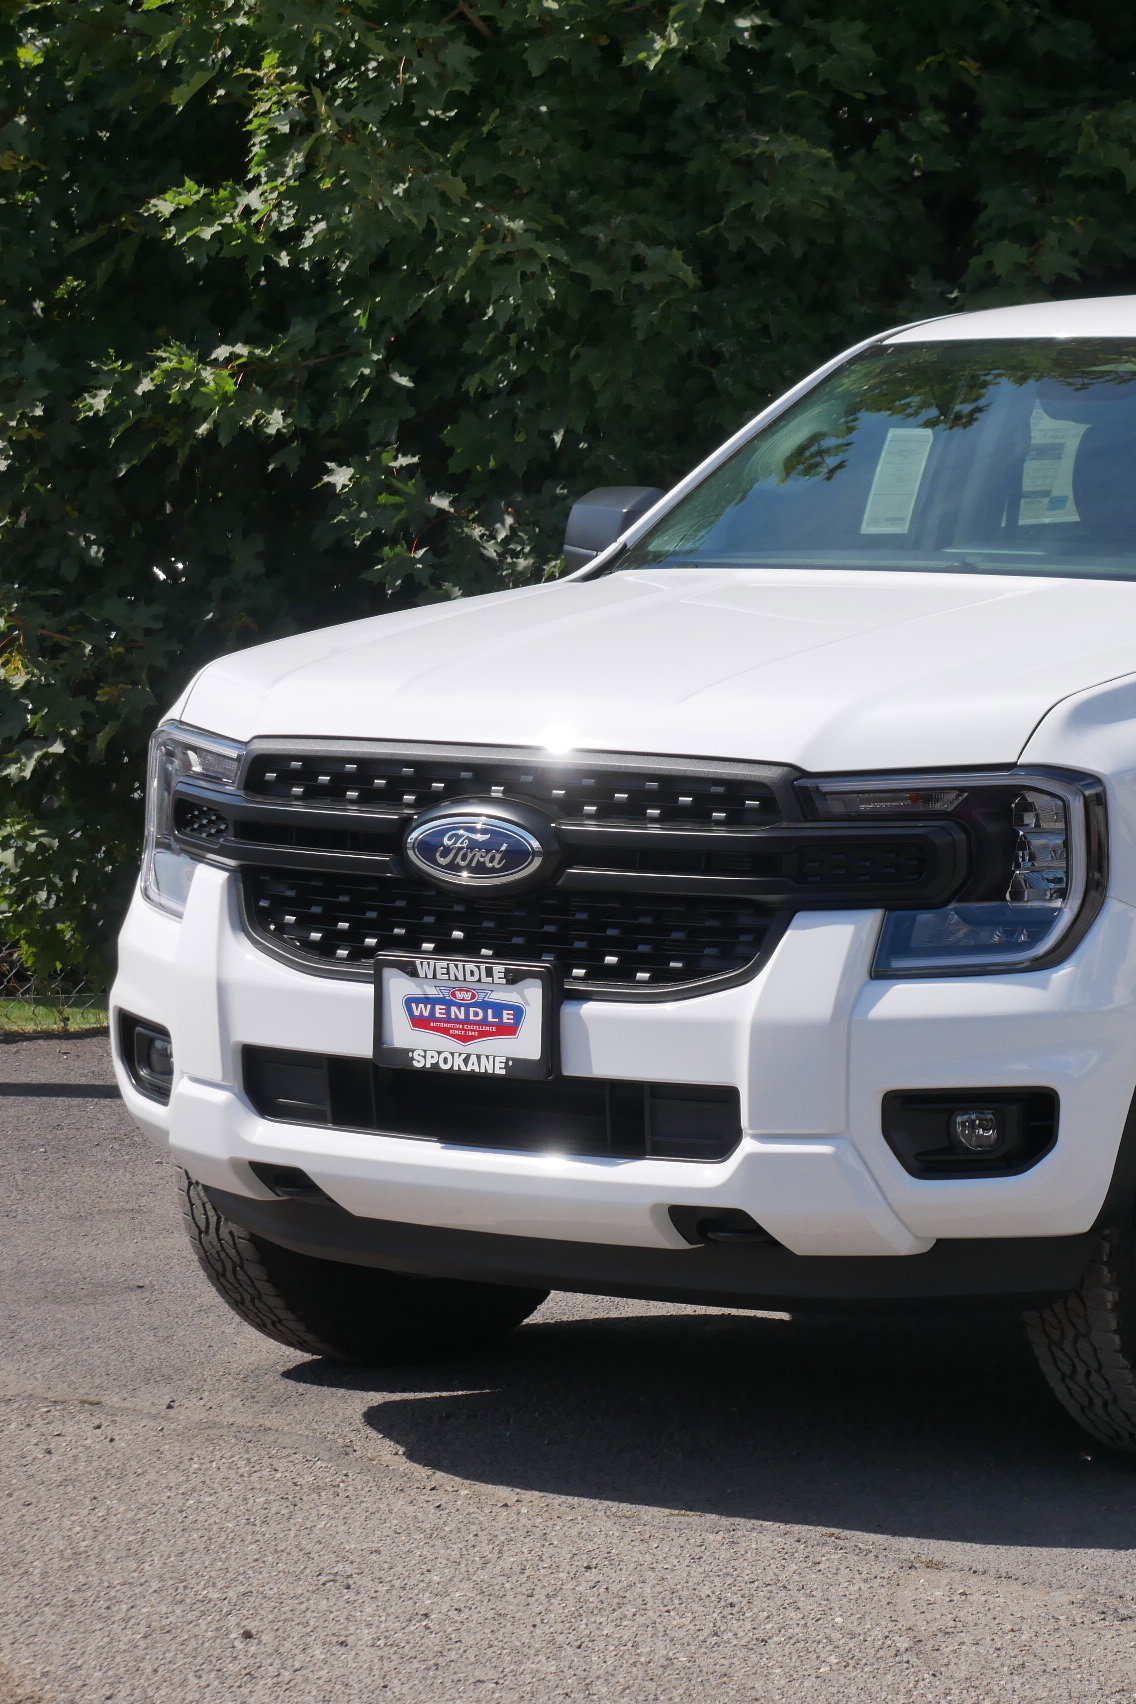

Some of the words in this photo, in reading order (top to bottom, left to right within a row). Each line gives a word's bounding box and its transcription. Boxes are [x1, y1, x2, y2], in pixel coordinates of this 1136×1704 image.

[435, 829, 508, 869] Ford
[415, 960, 507, 985] WENDLE
[411, 1002, 515, 1024] WENDLE
[430, 1021, 463, 1029] AUTOMOTIVE
[464, 1024, 497, 1032] EXCELLENCE
[412, 1050, 506, 1075] SPOKANE
